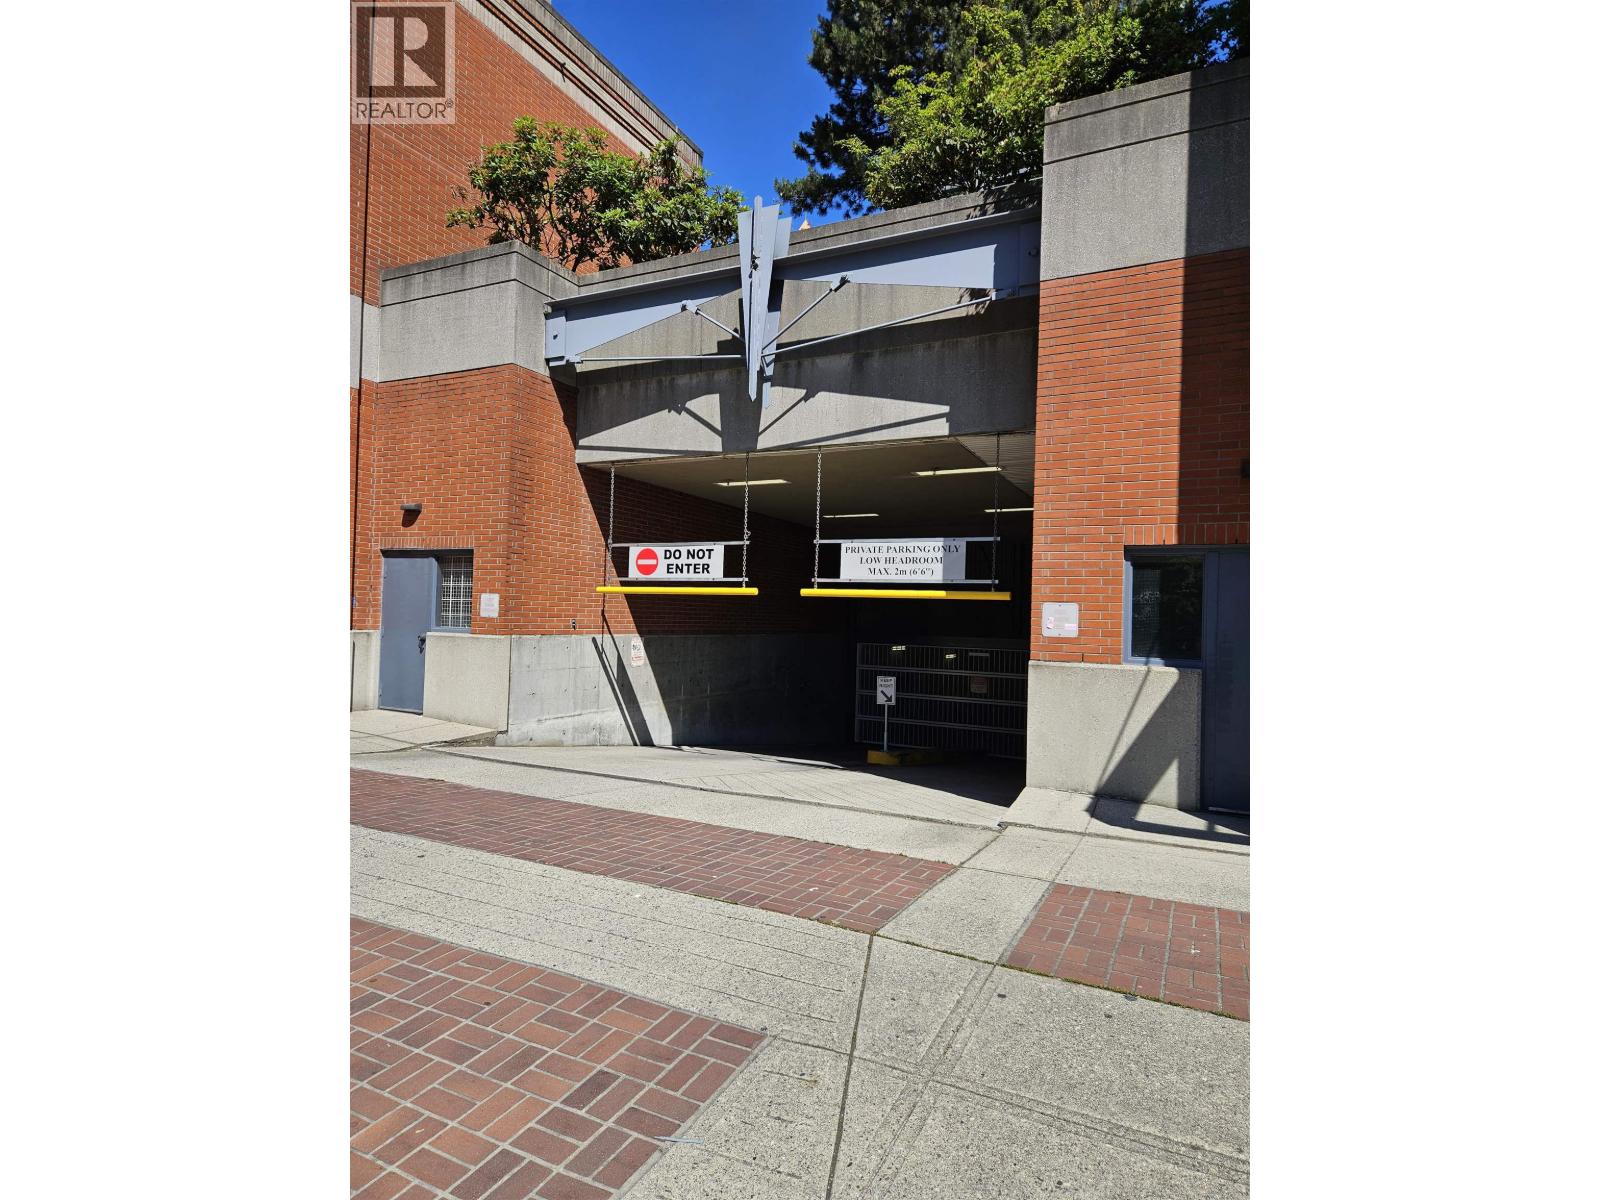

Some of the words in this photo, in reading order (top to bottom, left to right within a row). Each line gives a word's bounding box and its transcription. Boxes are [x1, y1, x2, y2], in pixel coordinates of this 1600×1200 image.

[845, 545, 884, 554] PRIVATE
[886, 545, 931, 554] PARKING
[932, 544, 961, 553] ONLY
[664, 549, 682, 560] DO
[686, 549, 714, 560] NOT
[859, 557, 881, 565] LOW
[884, 556, 943, 565] HEADROOM
[666, 563, 710, 574] ENTER
[868, 567, 892, 576] MAX.
[894, 567, 907, 576] 2m
